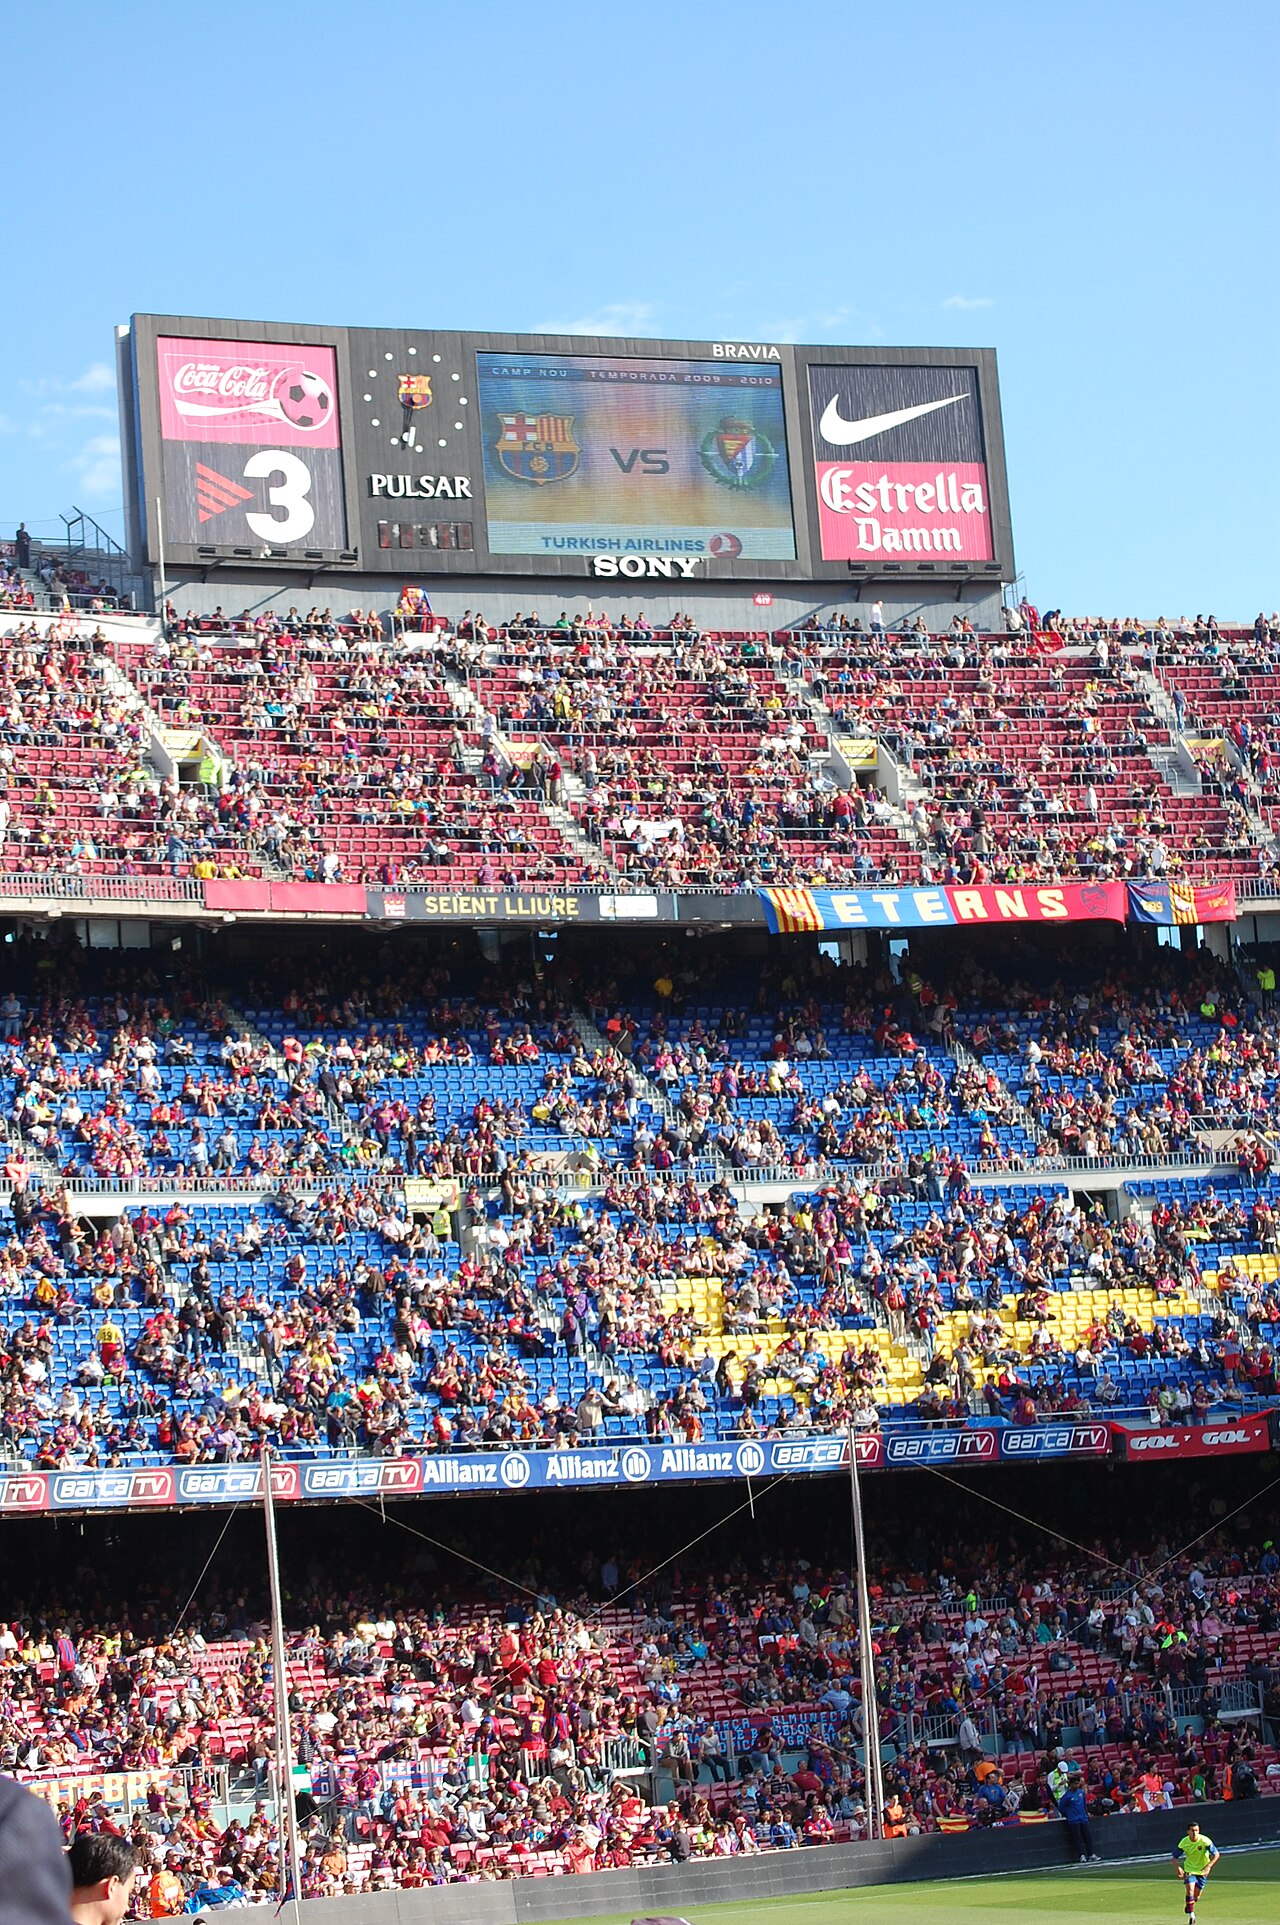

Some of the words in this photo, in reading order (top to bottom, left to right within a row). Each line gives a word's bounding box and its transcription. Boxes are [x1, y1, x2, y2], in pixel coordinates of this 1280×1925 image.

[713, 344, 782, 360] BRAVIA
[173, 362, 272, 398] Coca-Cola
[491, 367, 532, 377] CAMP
[539, 369, 569, 379] NOU
[590, 370, 677, 383] TEMPORADA
[684, 373, 721, 384] 2009
[739, 376, 774, 386] 2010
[609, 448, 670, 475] VS
[243, 449, 315, 544] 3
[371, 473, 473, 499] PULSAR
[820, 465, 987, 515] Estrella
[541, 536, 621, 551] TURKISH
[624, 538, 706, 552] AIRLINES
[853, 517, 964, 554] Damm
[593, 554, 701, 579] SONY
[424, 896, 500, 915] SEIENT
[504, 897, 580, 916] LLIURE
[830, 888, 1069, 923] ETERNS
[963, 1435, 991, 1452] TV
[1077, 1427, 1105, 1446] TV
[1129, 1435, 1180, 1450] GOL
[1201, 1429, 1251, 1445] GOL
[424, 1455, 498, 1484] Allianz
[545, 1451, 620, 1481] Allianz
[661, 1447, 734, 1474] Allianz
[135, 1475, 169, 1496] TV
[384, 1466, 415, 1485] TV
[8, 1482, 41, 1501] TV
